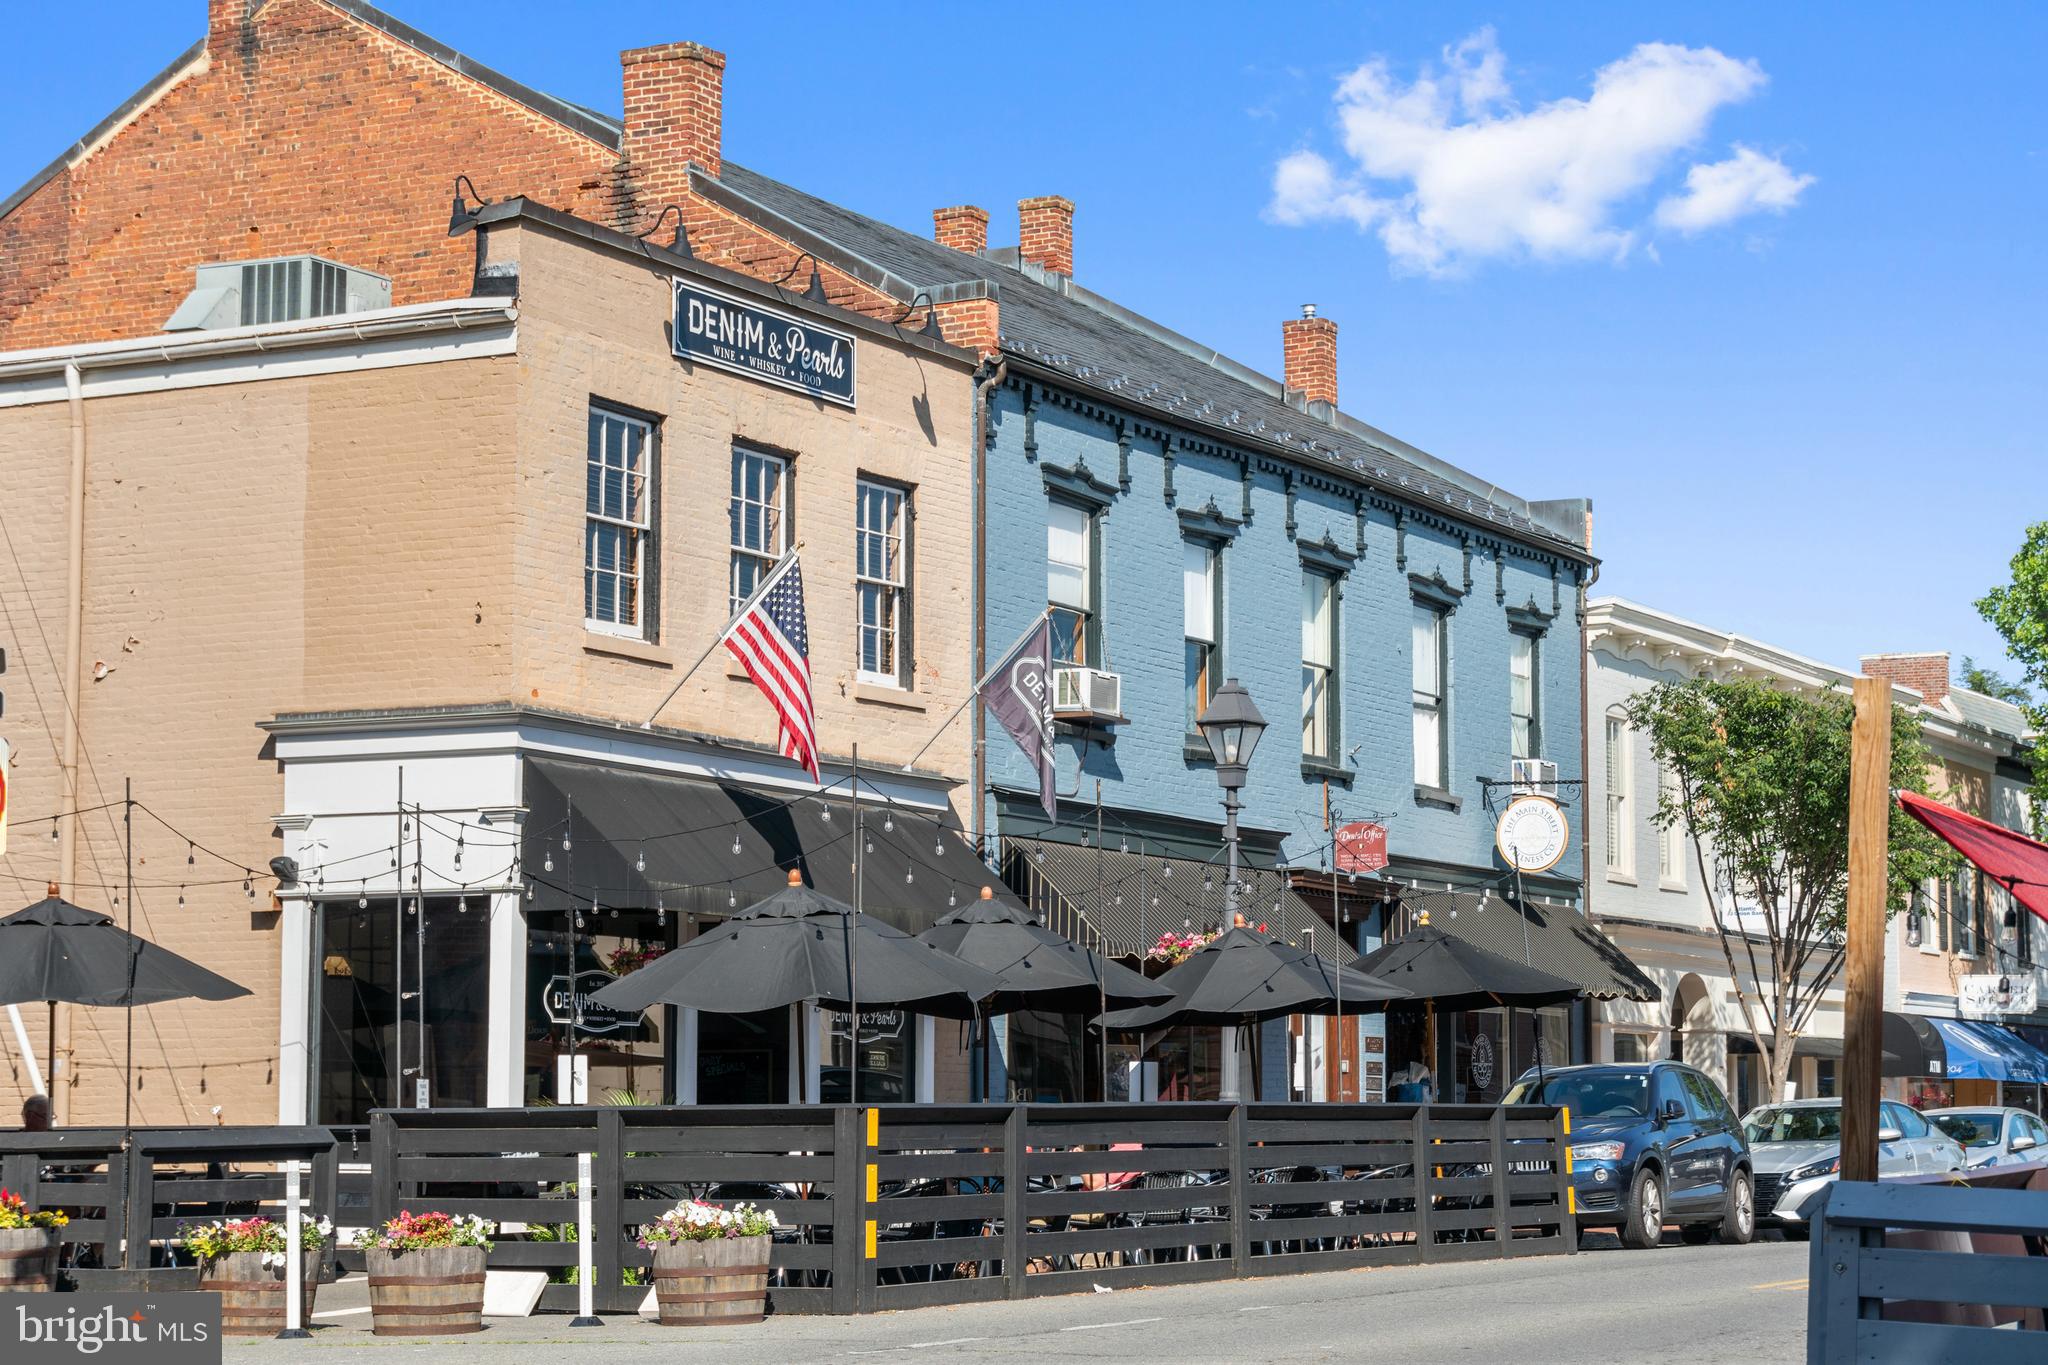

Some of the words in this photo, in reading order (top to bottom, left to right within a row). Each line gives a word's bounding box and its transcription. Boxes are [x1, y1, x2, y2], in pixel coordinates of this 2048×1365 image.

[688, 298, 764, 354] DENIM
[768, 332, 782, 360] &
[786, 326, 845, 379] Pearls
[713, 344, 736, 361] WINE
[749, 356, 787, 376] WHISKEY
[799, 371, 821, 387] FOOD
[1023, 671, 1054, 724] DEM
[1363, 827, 1383, 844] Office
[1504, 816, 1516, 833] THE
[1515, 806, 1538, 818] MAIN
[1540, 807, 1560, 833] STREET
[1964, 984, 2029, 994] CARER
